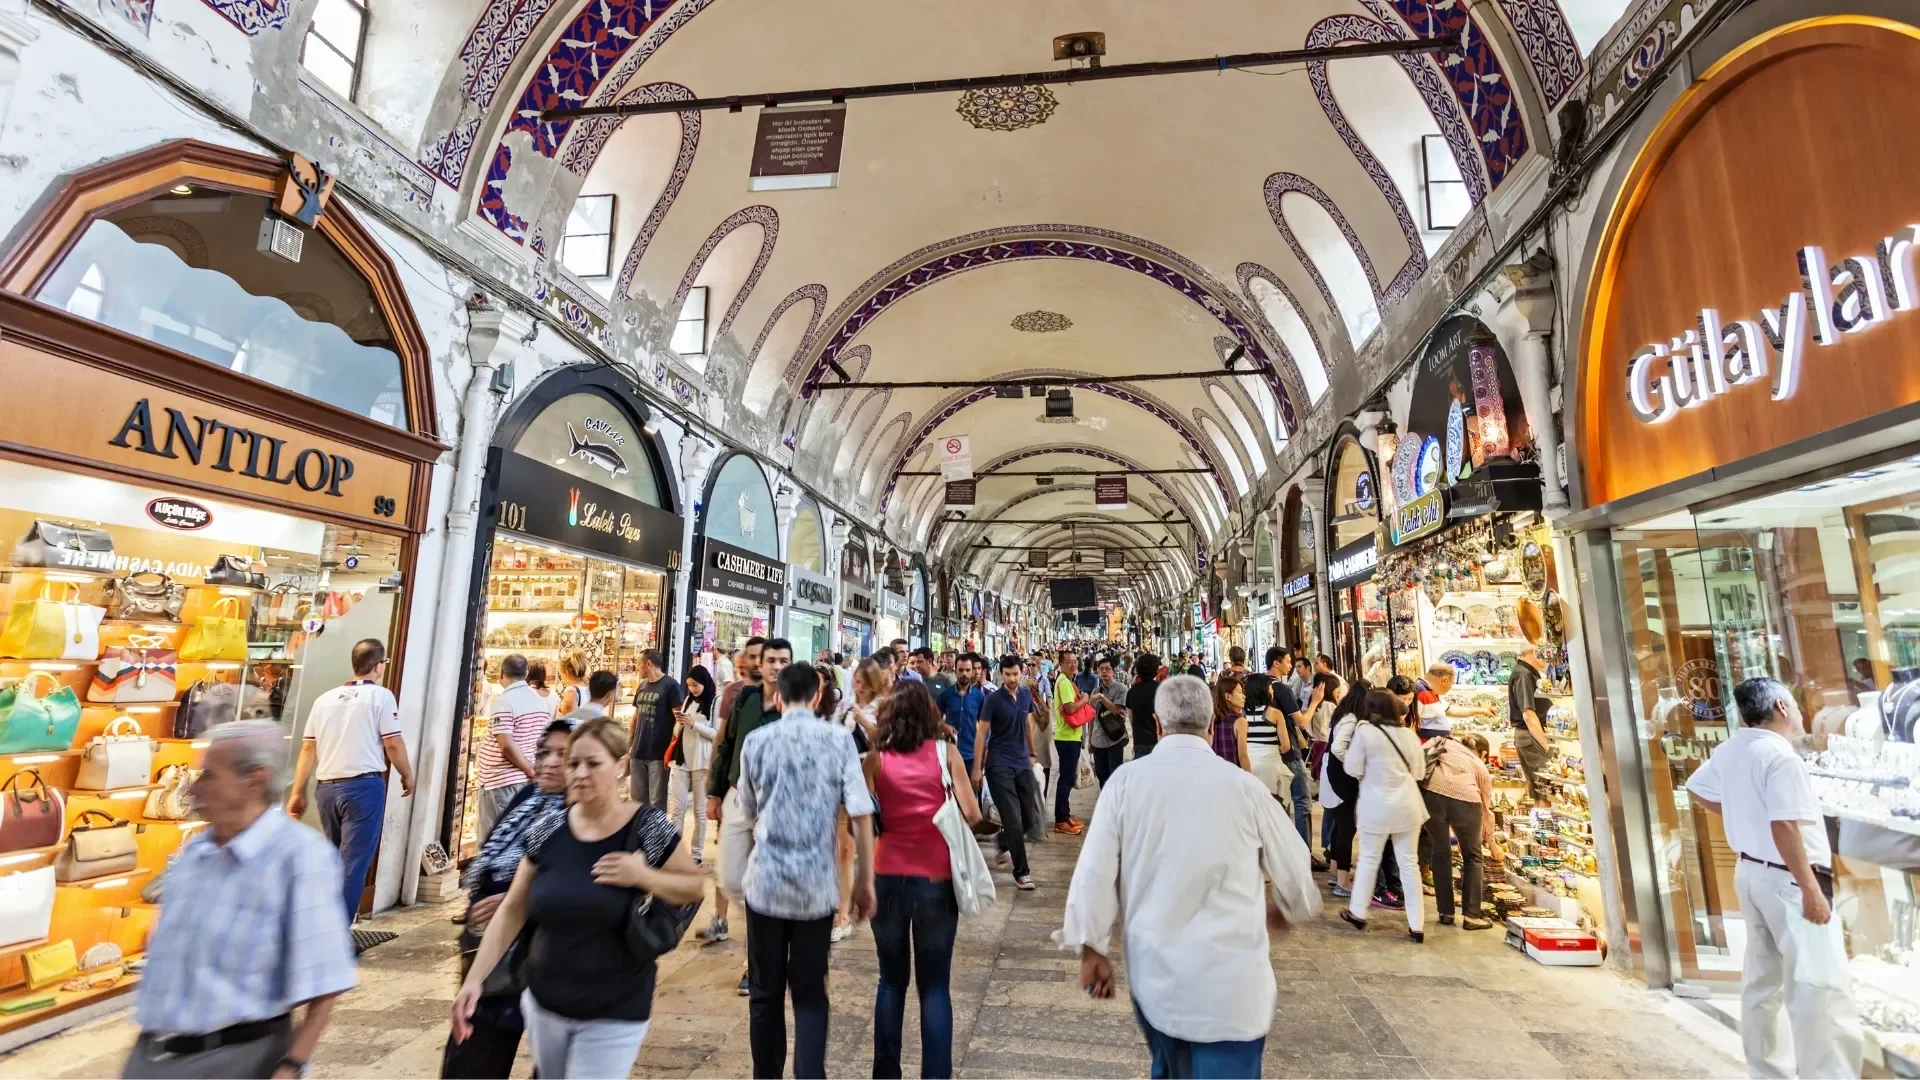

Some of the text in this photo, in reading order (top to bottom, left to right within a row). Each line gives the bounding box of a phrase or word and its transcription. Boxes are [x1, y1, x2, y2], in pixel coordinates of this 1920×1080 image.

[1625, 224, 1920, 425] Gülaylar
[1428, 344, 1448, 372] LOOM
[1448, 329, 1462, 355] ART
[109, 397, 355, 497] ANTILOP
[585, 416, 626, 446] CAVIAR
[374, 494, 396, 517] 99
[498, 500, 527, 532] 101
[1421, 494, 1440, 525] Art
[717, 551, 784, 585] CASHMERE LIFE
[1688, 676, 1722, 700] 80
